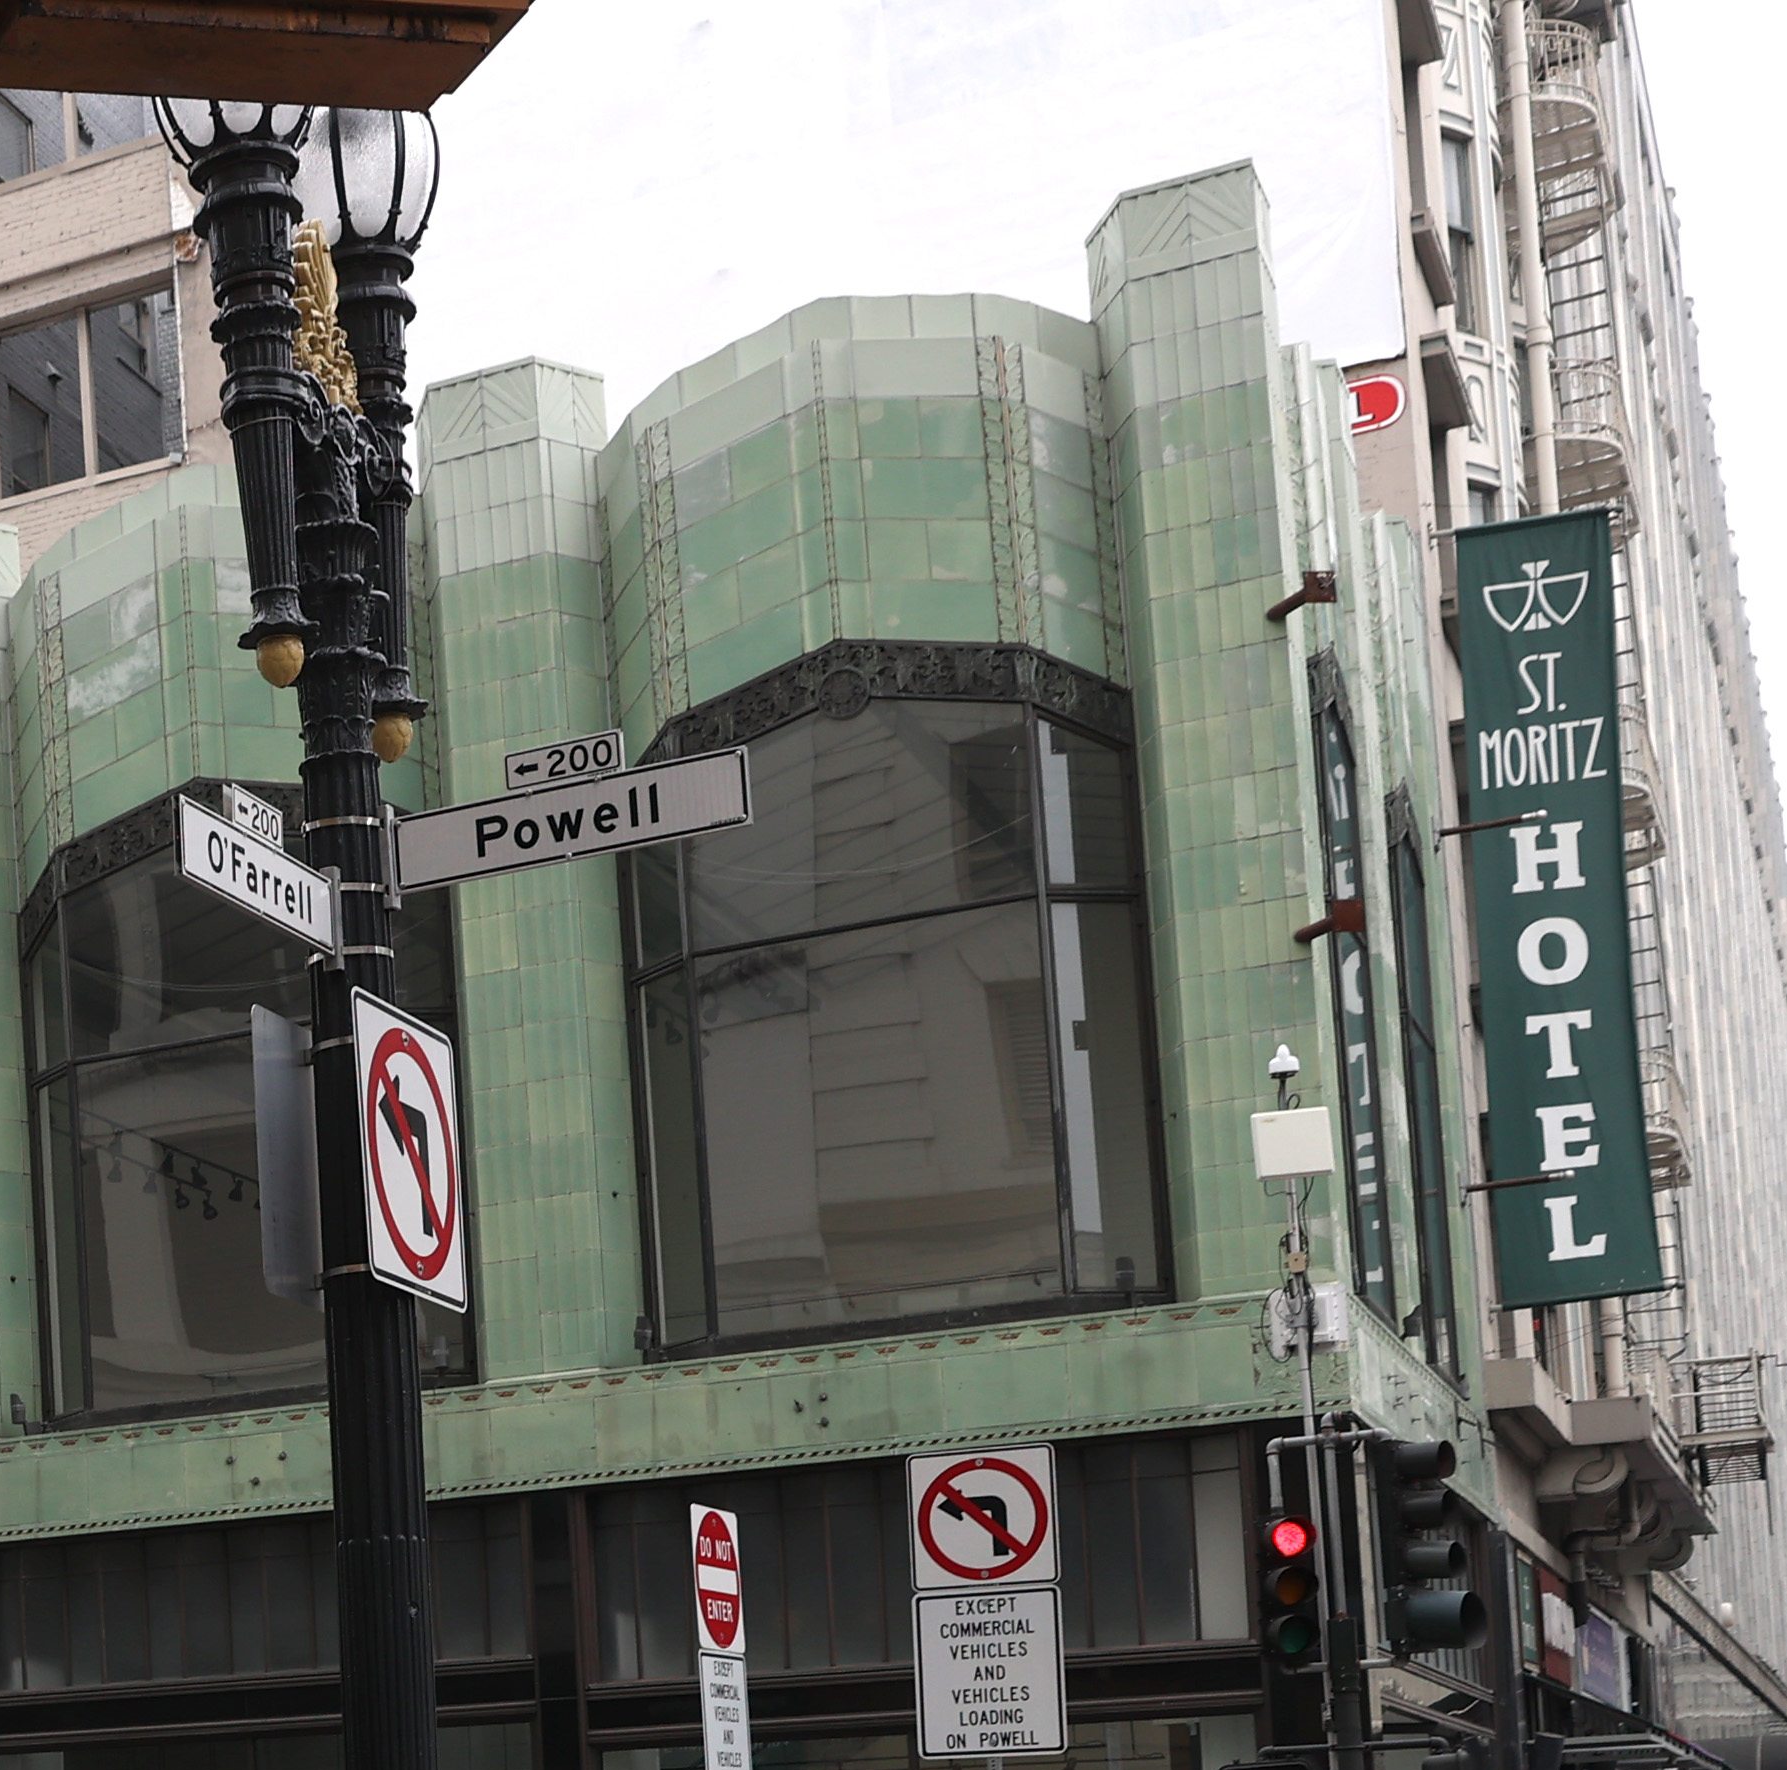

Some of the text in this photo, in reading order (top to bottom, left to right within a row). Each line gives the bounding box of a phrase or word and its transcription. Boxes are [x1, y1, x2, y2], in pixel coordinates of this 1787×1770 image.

[1516, 652, 1567, 716] ST.
[547, 740, 613, 779] 200
[1478, 716, 1608, 790] MORITZ
[251, 805, 280, 843] 200
[475, 783, 661, 858] Powell
[207, 829, 314, 925] O'Farrell
[1511, 819, 1608, 1261] HOTEL
[700, 1536, 731, 1561] DO NOT
[707, 1599, 733, 1622] ENTER
[955, 1597, 1016, 1615] EXCEPT
[940, 1619, 1034, 1639] COMMERCIAL
[950, 1641, 1028, 1660] VEHICLES
[974, 1665, 1006, 1681] AND
[952, 1686, 1030, 1704] VEHICLES
[960, 1709, 1023, 1726] LOADING
[946, 1730, 1039, 1749] ON POWELL
